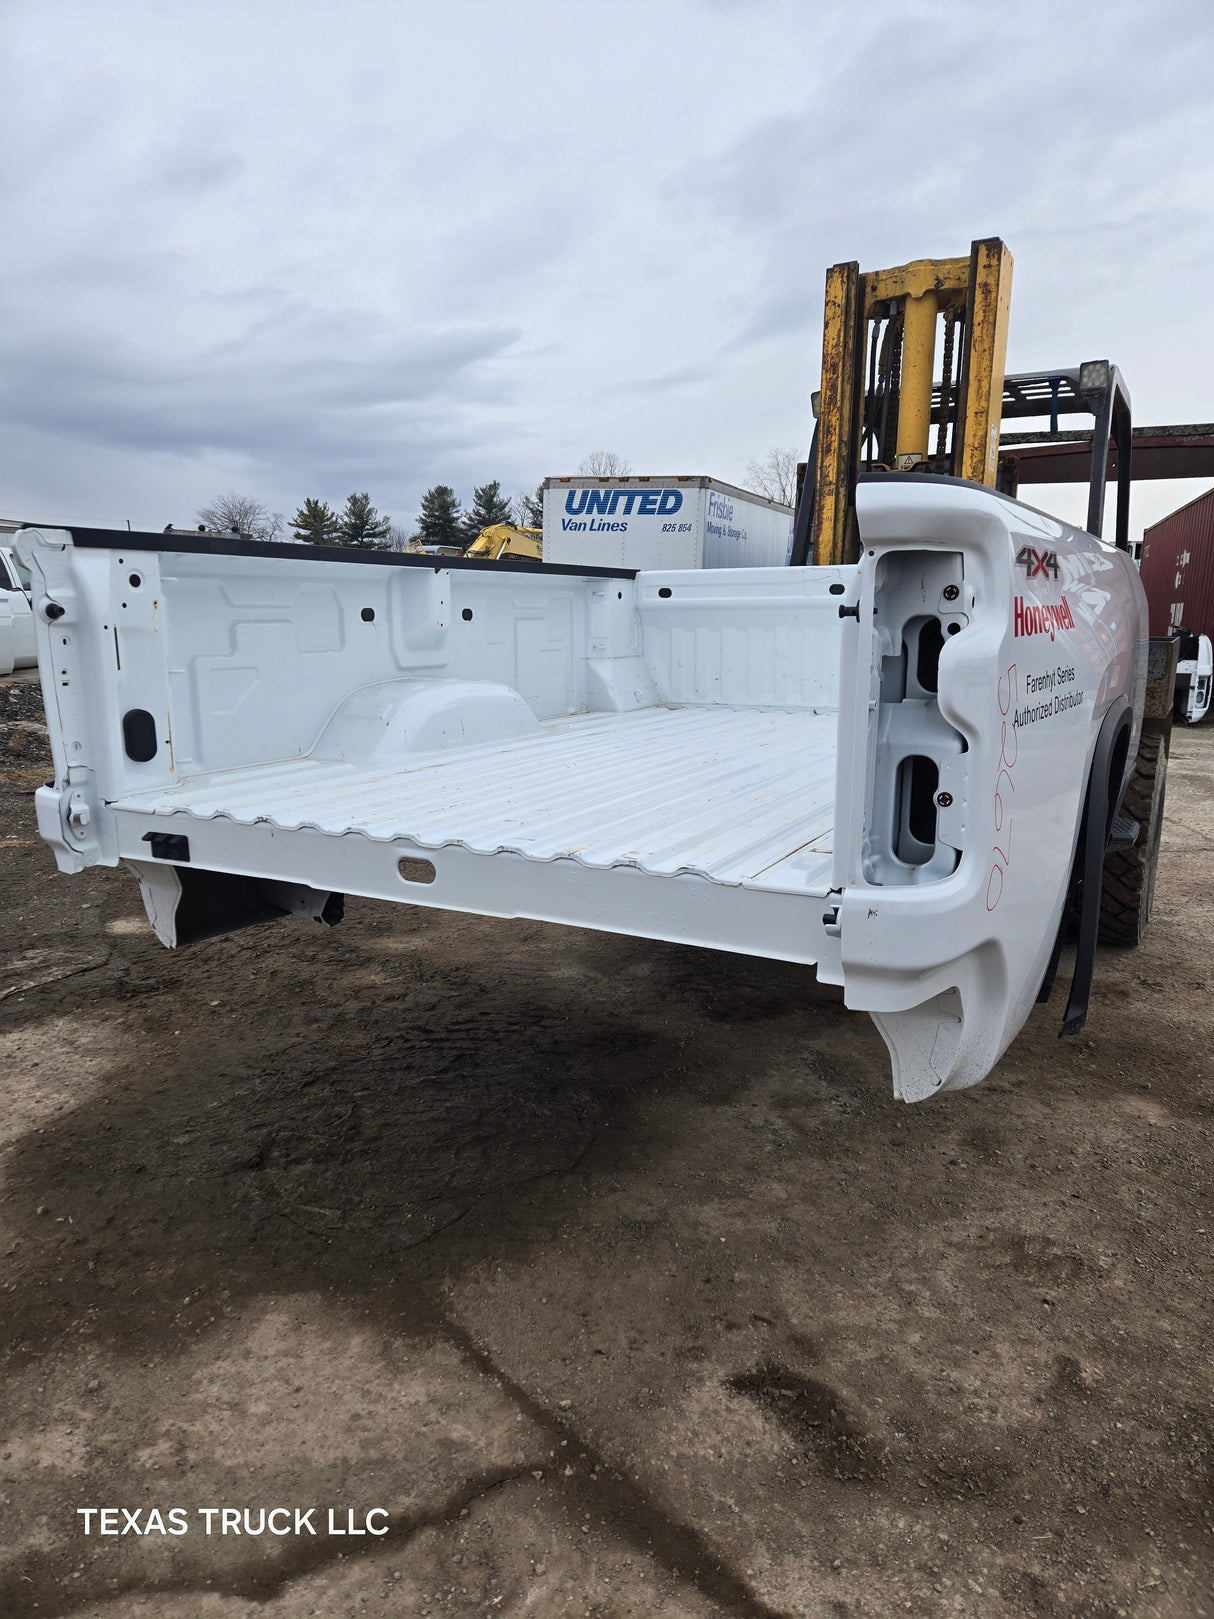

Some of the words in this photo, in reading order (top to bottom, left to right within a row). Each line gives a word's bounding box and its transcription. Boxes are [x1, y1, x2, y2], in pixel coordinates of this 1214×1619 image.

[565, 489, 683, 515] UNITED
[708, 491, 734, 521] Frisbie
[561, 518, 587, 531] Van
[588, 518, 628, 532] Lines
[661, 523, 677, 532] 825
[677, 523, 692, 532] 854
[707, 520, 722, 537] Moving
[727, 525, 741, 541] Storage
[1014, 596, 1075, 641] Honeywell
[1026, 669, 1056, 694] Farenhyt
[1056, 665, 1075, 685] Series
[1013, 697, 1053, 728] Authorized
[1054, 689, 1084, 714] Distributor
